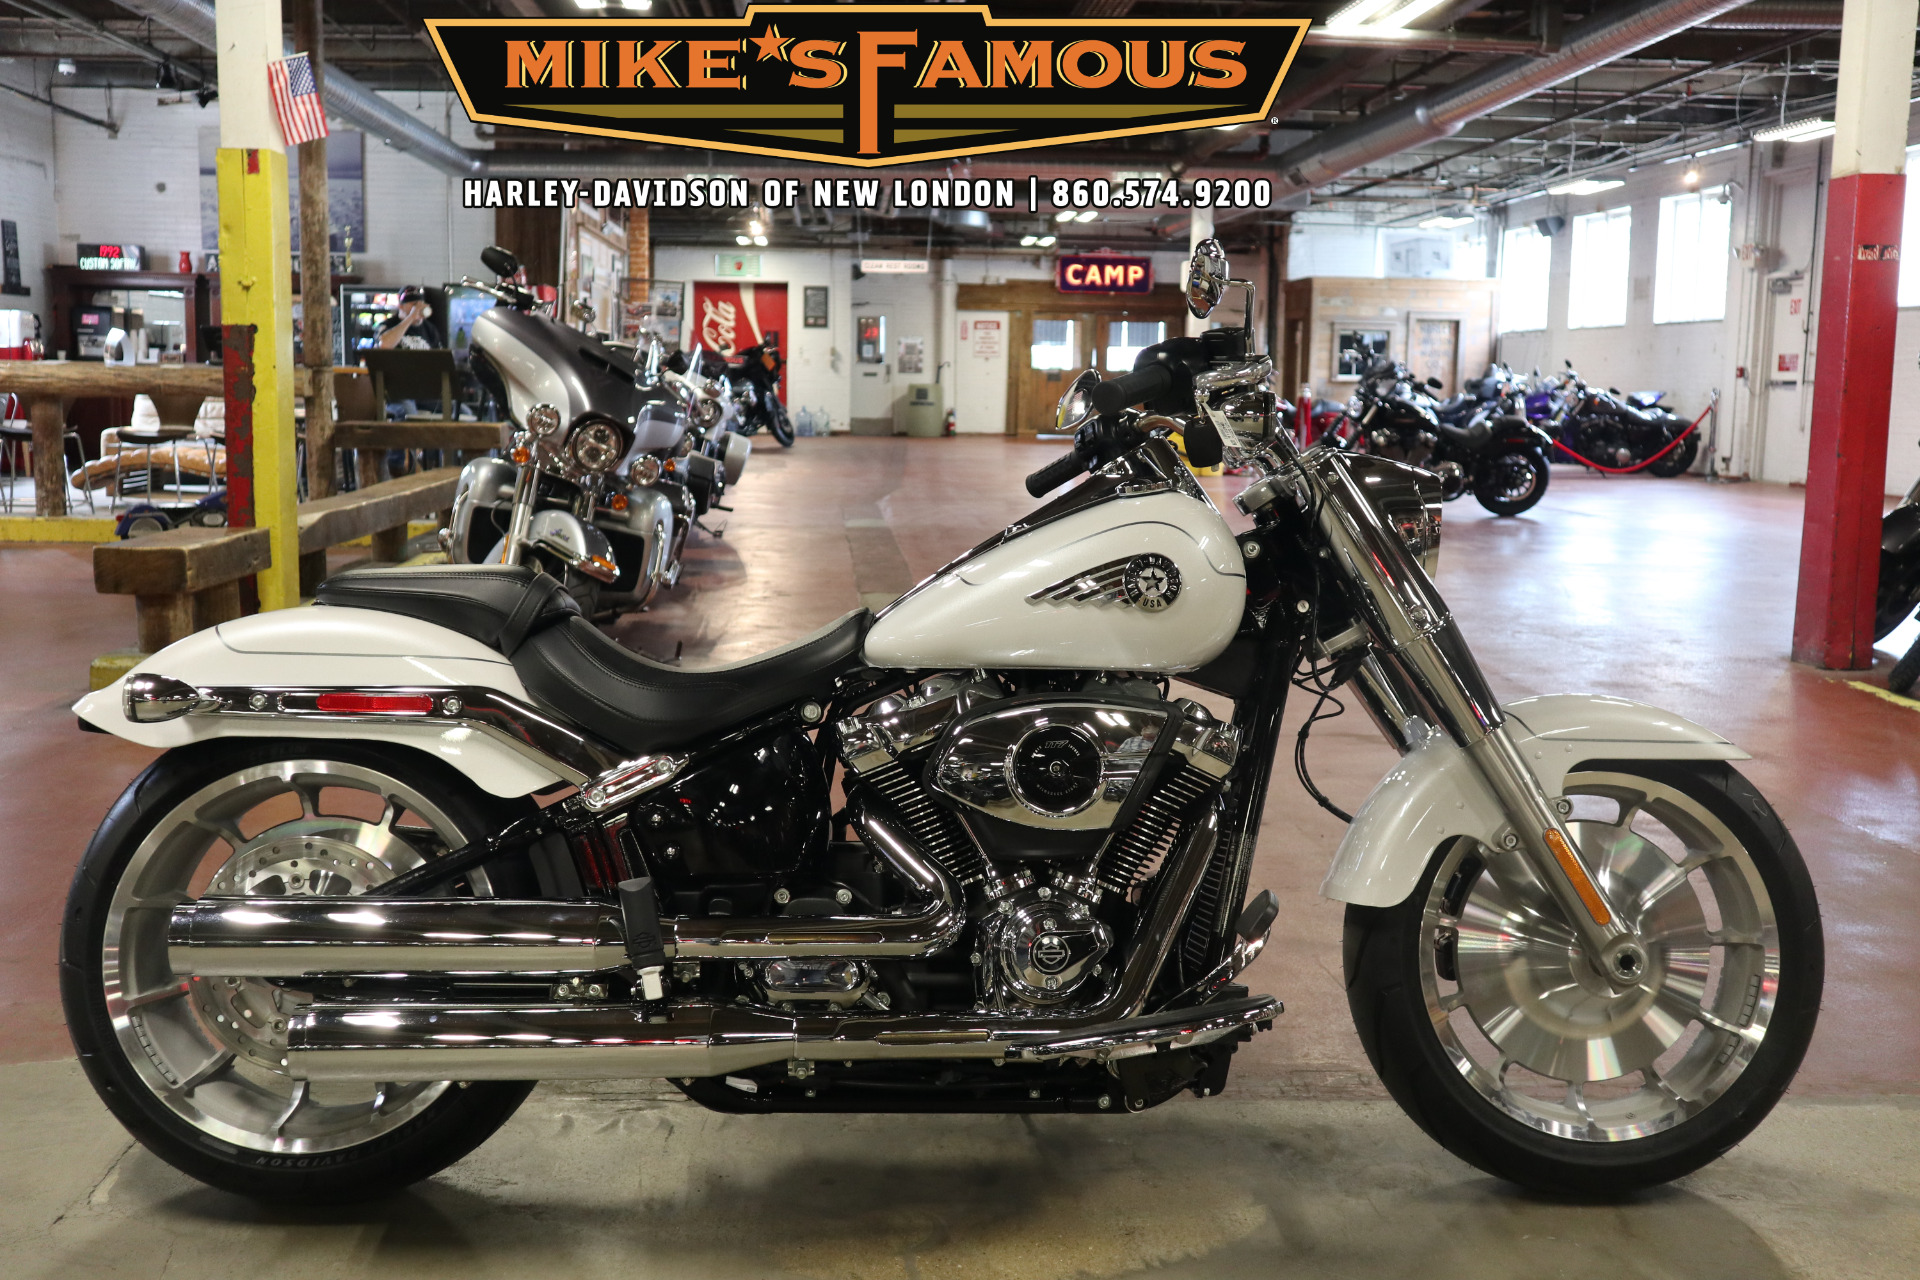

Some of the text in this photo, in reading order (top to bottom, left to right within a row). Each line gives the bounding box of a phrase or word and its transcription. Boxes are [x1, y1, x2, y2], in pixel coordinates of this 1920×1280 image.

[80, 257, 109, 270] CUSTOM
[1064, 263, 1145, 287] CAMP
[1142, 598, 1162, 608] USA
